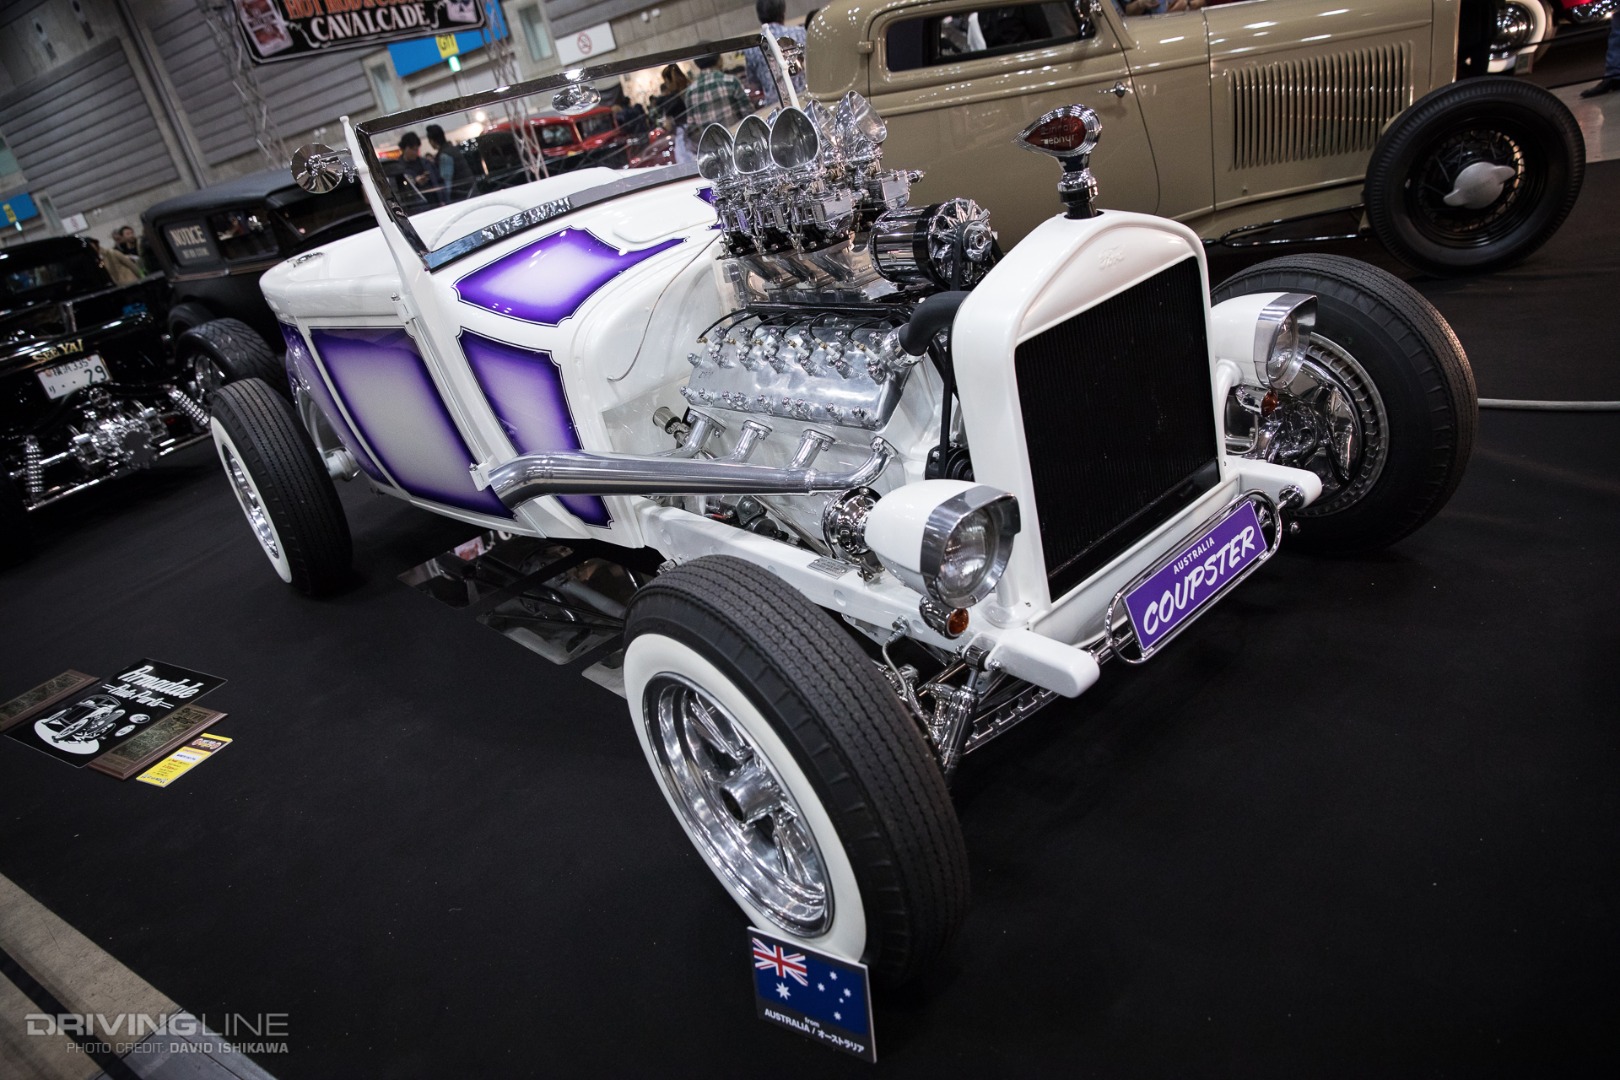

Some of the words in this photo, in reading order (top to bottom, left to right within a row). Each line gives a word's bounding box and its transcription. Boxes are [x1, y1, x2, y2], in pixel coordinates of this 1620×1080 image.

[310, 4, 430, 41] CAVALCADE
[169, 225, 207, 247] NOTICE
[32, 347, 61, 363] SEE
[1173, 537, 1215, 575] AUSTRALIA
[1143, 525, 1256, 636] COUPSTER
[764, 1008, 811, 1033] AUSTRALIA
[817, 1029, 865, 1053] オーストラリア
[804, 1016, 820, 1028] from
